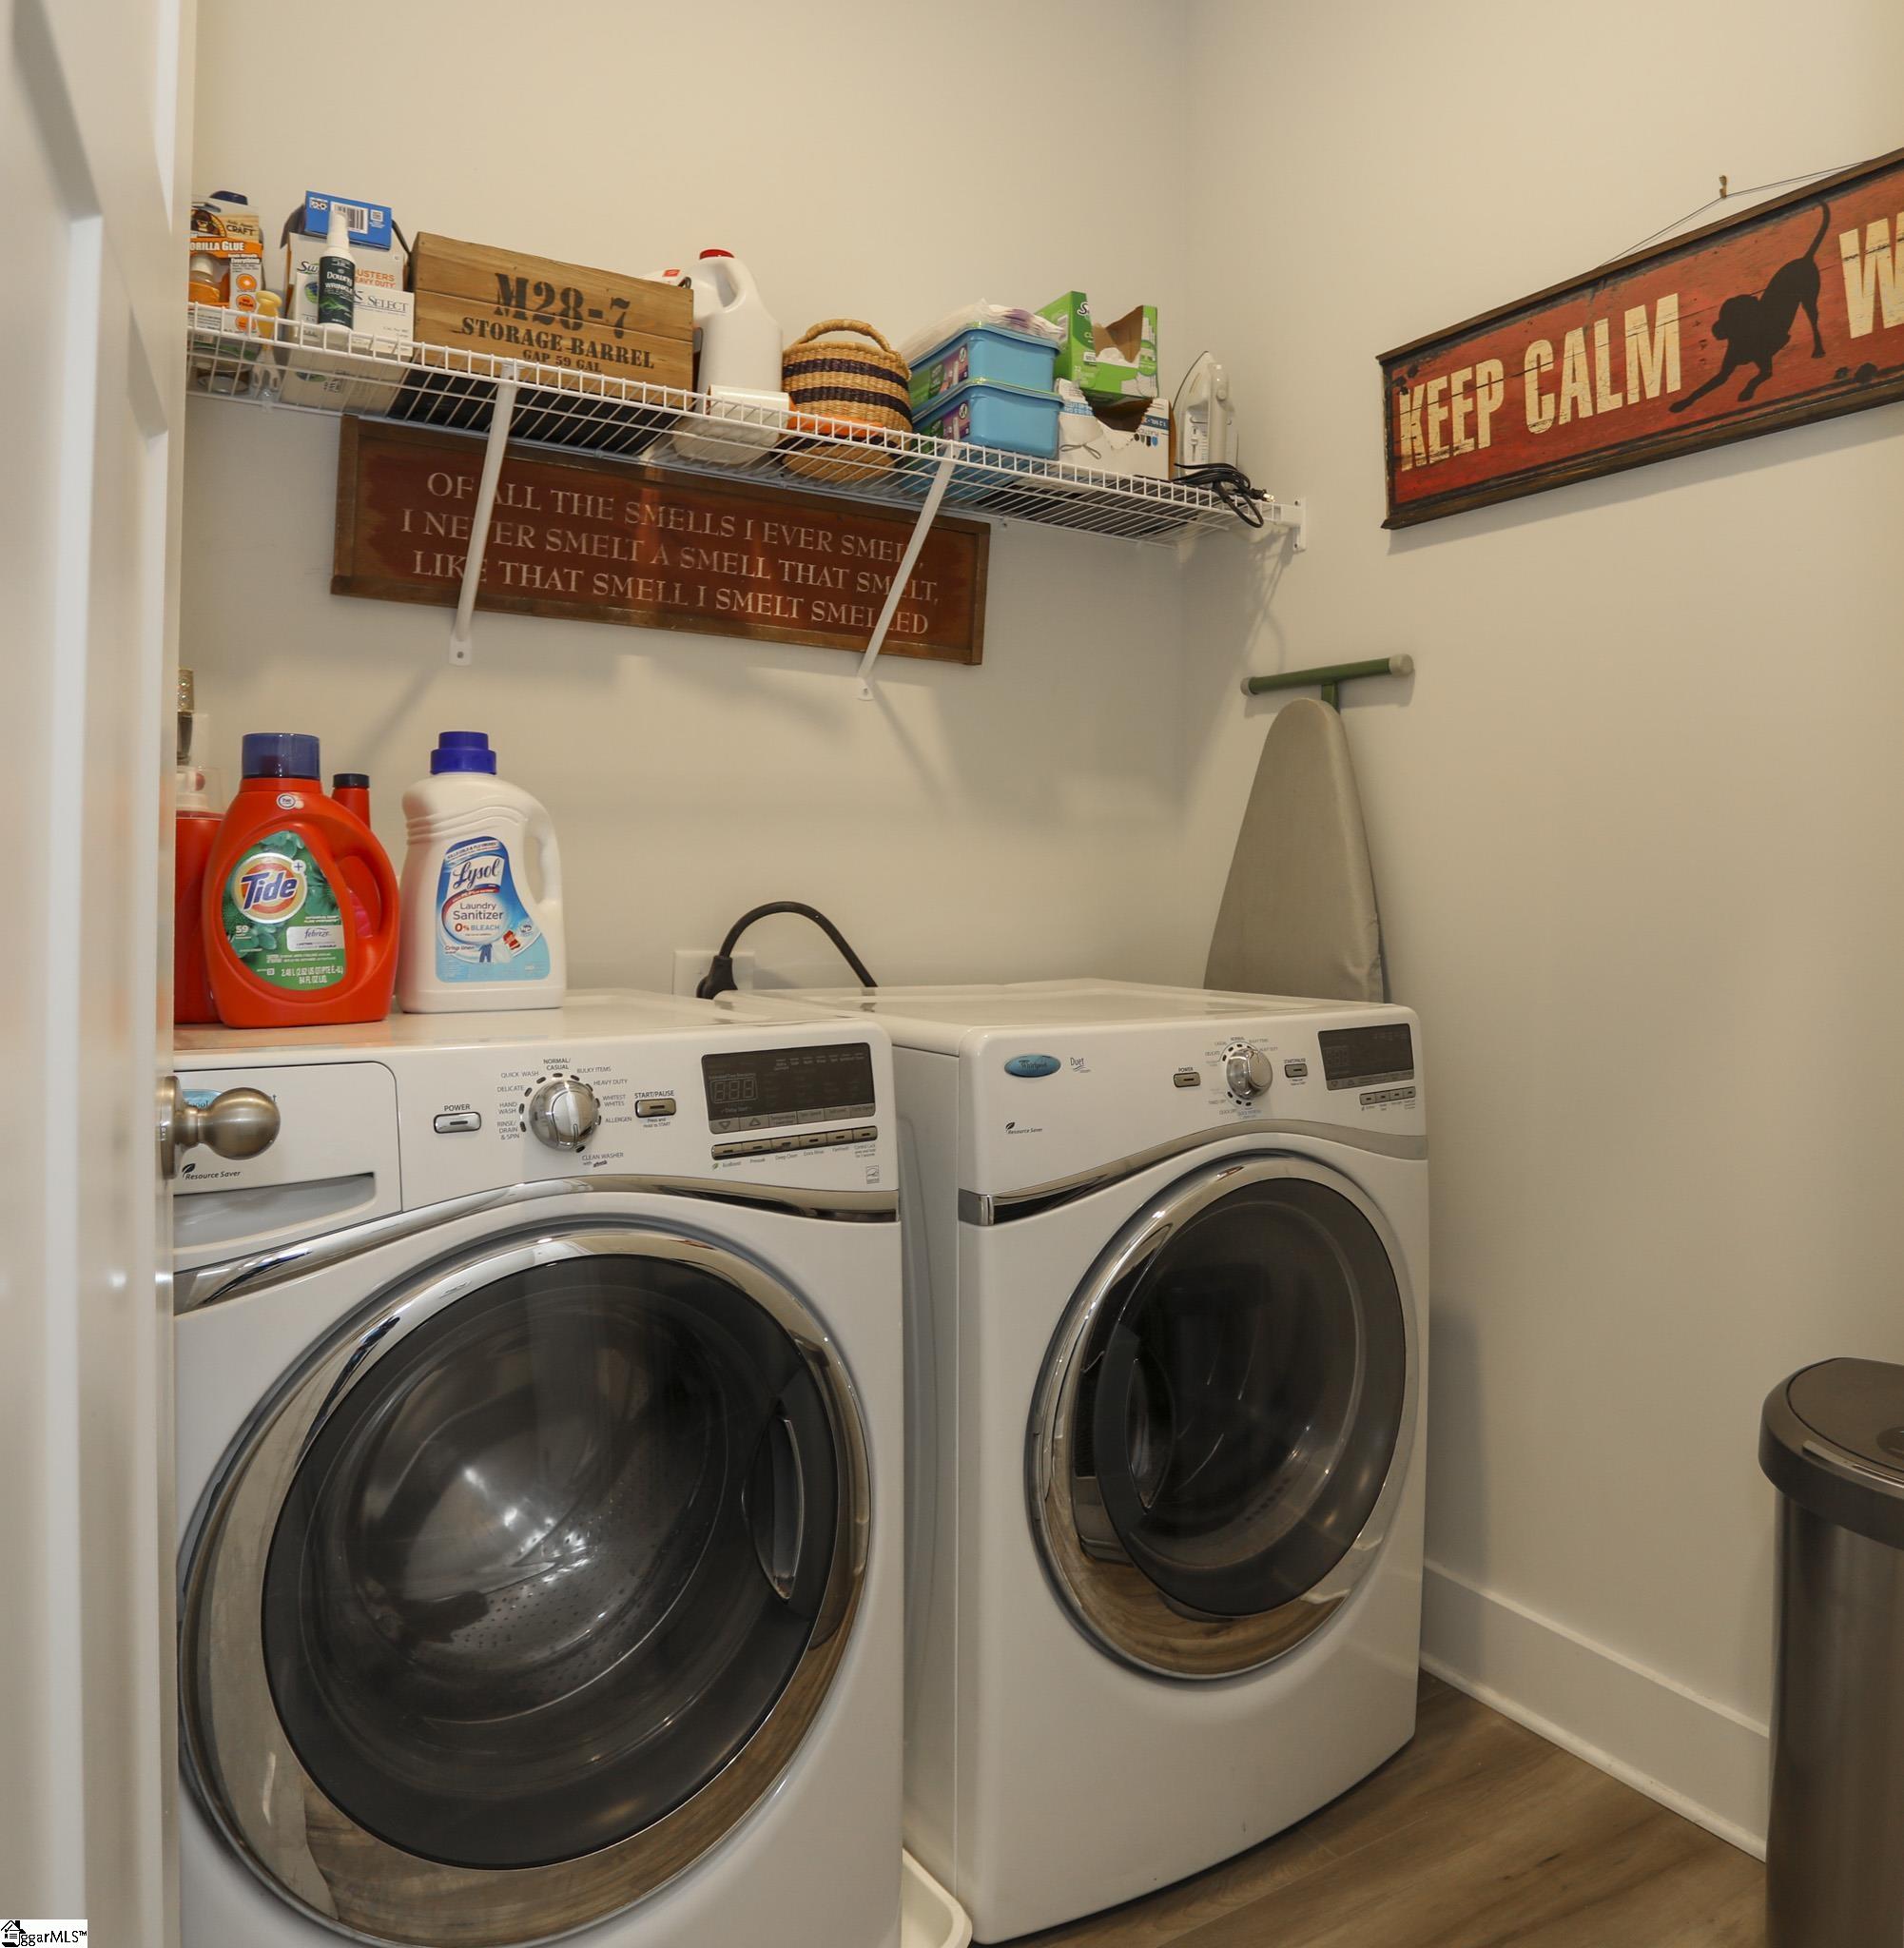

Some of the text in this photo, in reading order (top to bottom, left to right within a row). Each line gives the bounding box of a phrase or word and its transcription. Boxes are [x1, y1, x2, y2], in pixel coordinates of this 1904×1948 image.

[226, 224, 254, 236] CRAFT
[189, 242, 220, 251] ORILLA
[326, 271, 353, 286] Downy
[355, 276, 396, 288] EAVY DUTY
[357, 269, 395, 281] USTERS
[368, 296, 409, 311] SELECT
[495, 272, 631, 340] M28-7
[461, 317, 654, 370] STORAGE BARREL
[523, 349, 601, 373] GAP 59 GAL
[1399, 359, 1505, 473] KEEP
[1524, 293, 1681, 435] CALM
[427, 472, 475, 499] OF
[551, 489, 614, 521] THE
[625, 501, 736, 537] SMELLS
[745, 518, 754, 540] I
[762, 522, 833, 553] EVER
[841, 535, 923, 569] SMEL,
[401, 509, 939, 605] I NEER SMELT A SMELL THAT SMLT,
[498, 560, 584, 593] THAT
[593, 573, 689, 606] SMELL
[696, 585, 708, 607] I
[715, 589, 804, 619] SMELT
[811, 600, 929, 634] SMELED
[453, 858, 500, 889] Lysol
[241, 872, 298, 910] Tide
[453, 909, 503, 921] Sanitizer
[459, 903, 496, 913] Laundry
[455, 923, 470, 932] 0%
[1070, 1057, 1084, 1066] Duet
[444, 1103, 471, 1112] POWER
[185, 1171, 219, 1179] Resource
